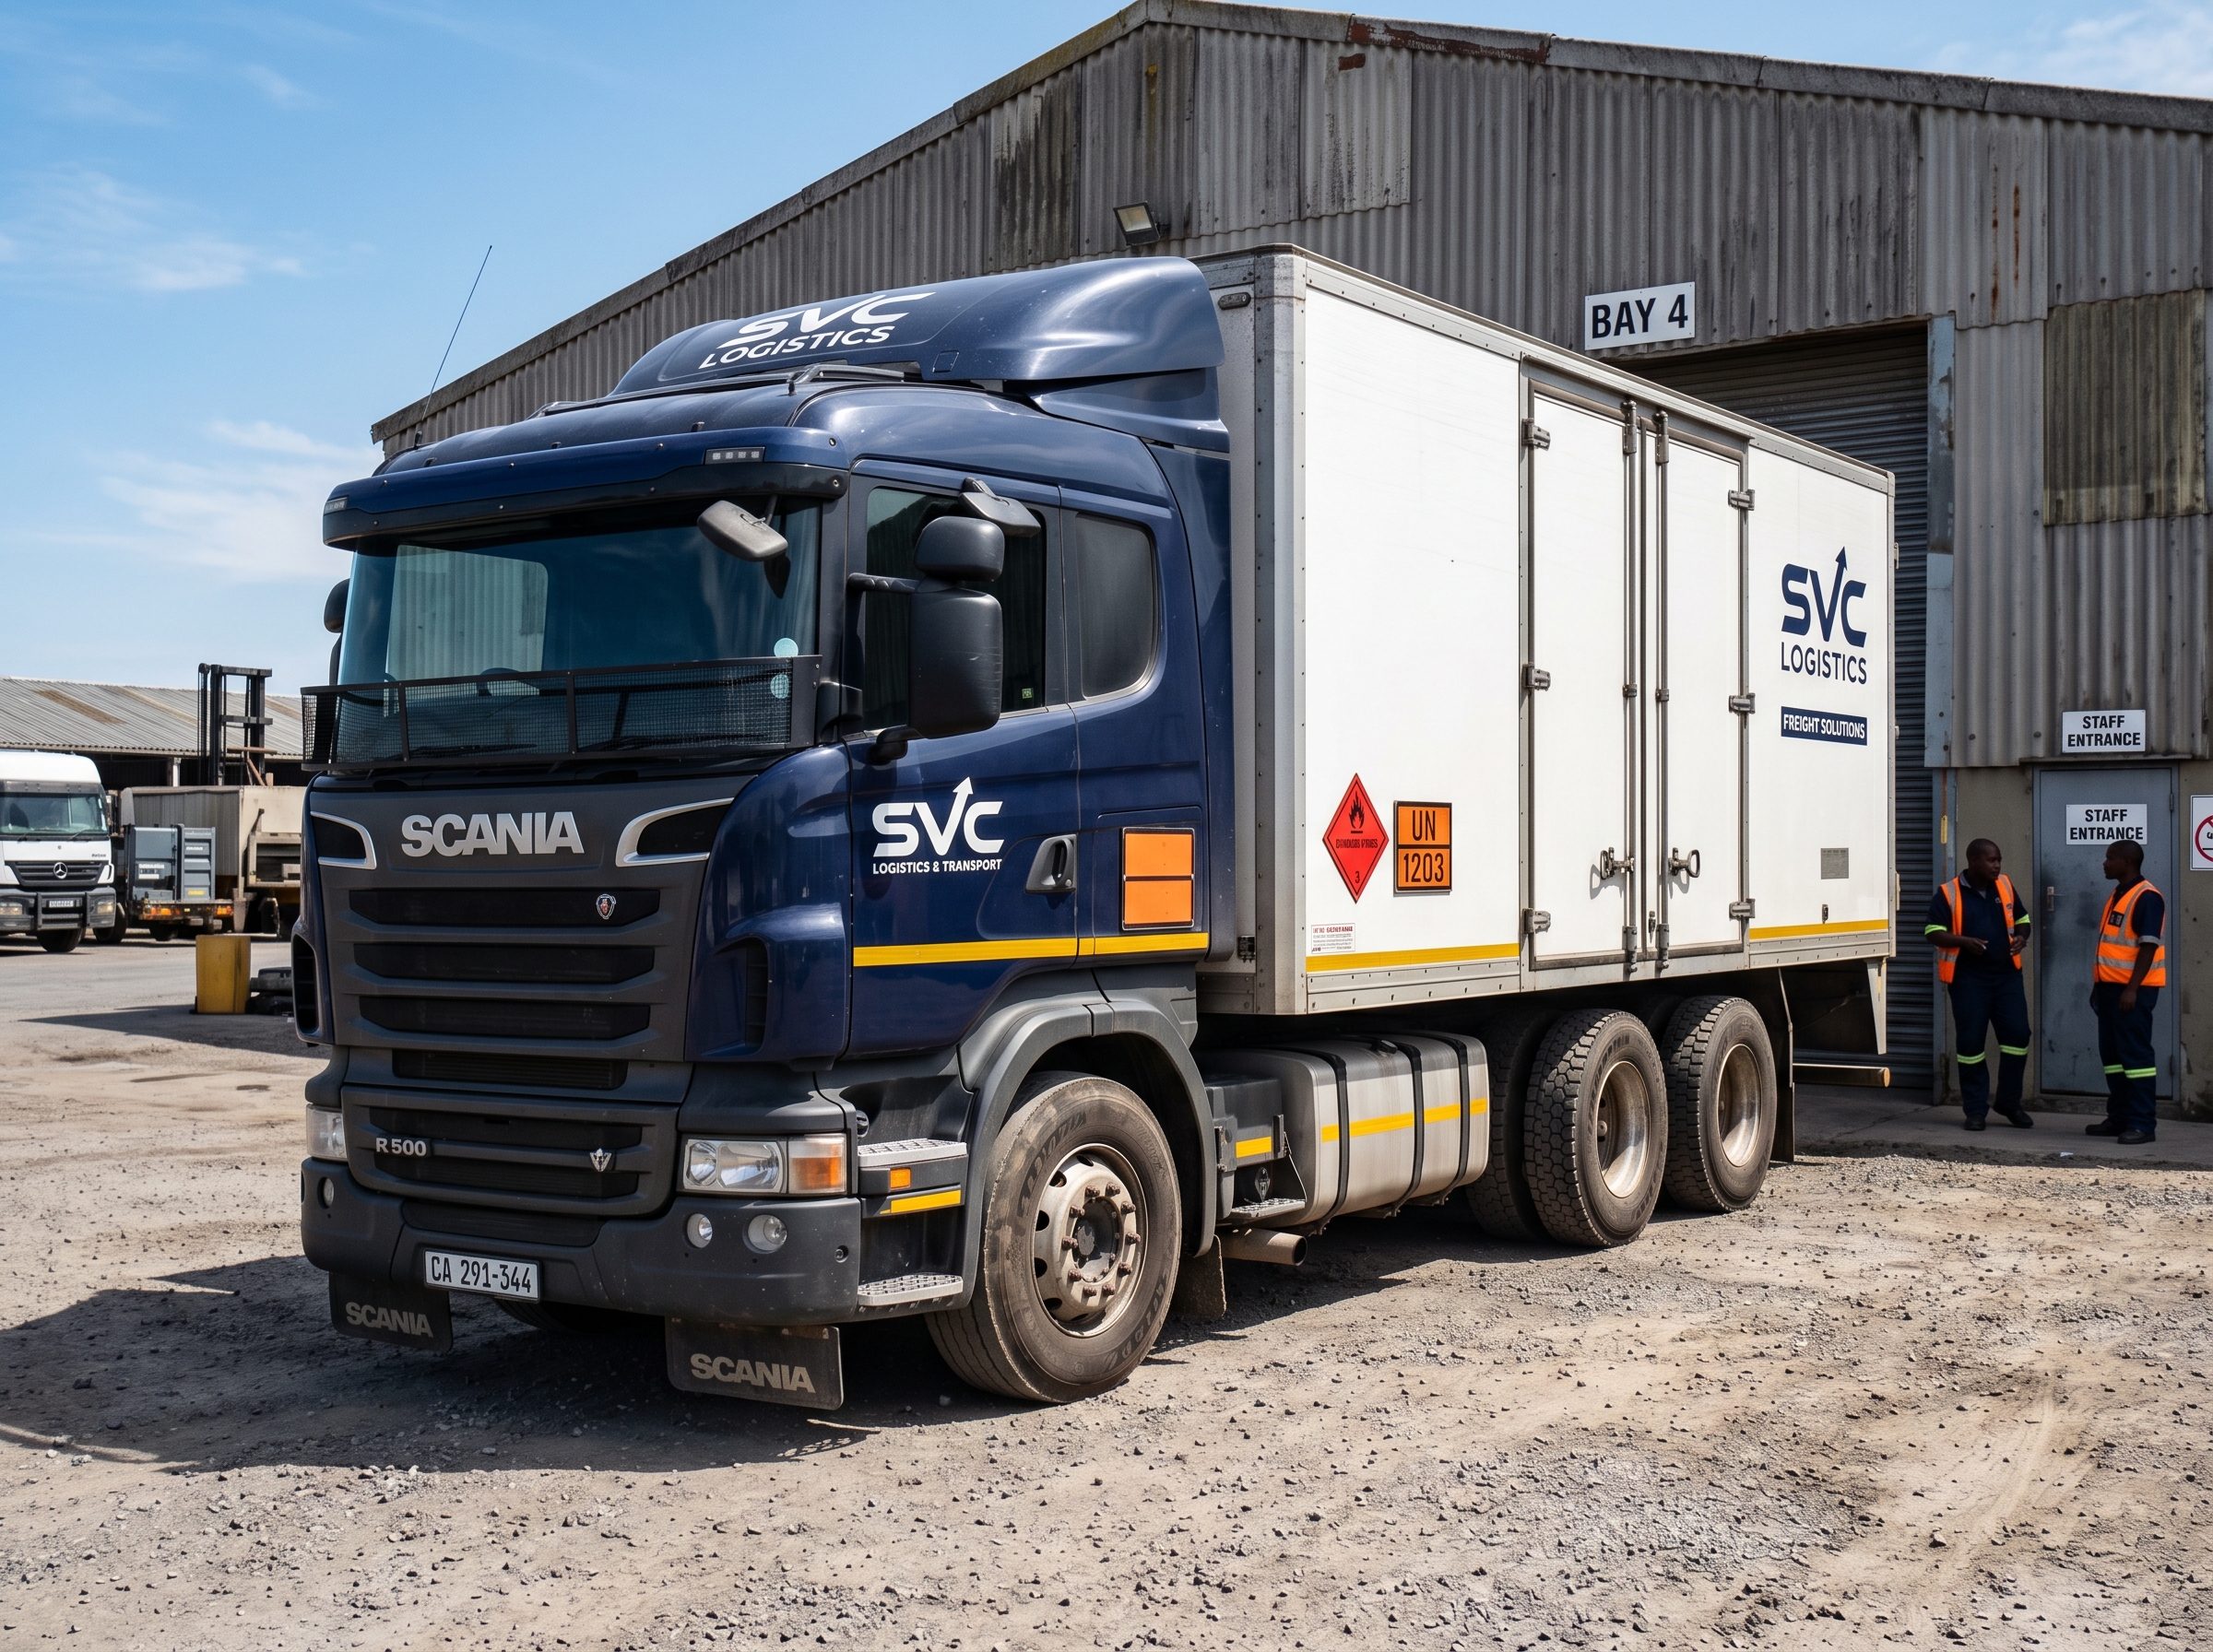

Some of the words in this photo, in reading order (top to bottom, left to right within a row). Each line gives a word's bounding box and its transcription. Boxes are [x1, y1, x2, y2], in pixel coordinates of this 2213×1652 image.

[716, 291, 936, 348] SVC
[1592, 297, 1657, 339] BAY
[1667, 293, 1688, 329] 4
[698, 325, 895, 369] LOGISTICS
[1781, 546, 1867, 648] SVC
[1781, 641, 1867, 685] LOGISTICS
[1783, 714, 1820, 734] FREIGHT
[1820, 718, 1865, 739] SOLUTIONS
[2082, 714, 2125, 729] STAFF
[2067, 732, 2141, 748] ENTRANCE
[871, 776, 1005, 857] SVC
[1412, 809, 1437, 842] UN
[2085, 808, 2127, 822] STAFF
[401, 810, 585, 857] SCANIA
[2069, 826, 2144, 841] ENTRANCE
[872, 861, 930, 875] LOGISTICS
[932, 861, 940, 872] &
[941, 858, 1002, 872] TRANSPORT
[1355, 870, 1360, 884] 3
[1403, 853, 1445, 883] 1203
[375, 1137, 389, 1153] R
[391, 1138, 427, 1157] 500
[432, 1256, 452, 1283] CA
[460, 1259, 531, 1293] 291-344
[345, 1302, 434, 1339] SCANIA
[690, 1352, 816, 1394] SCANIA
